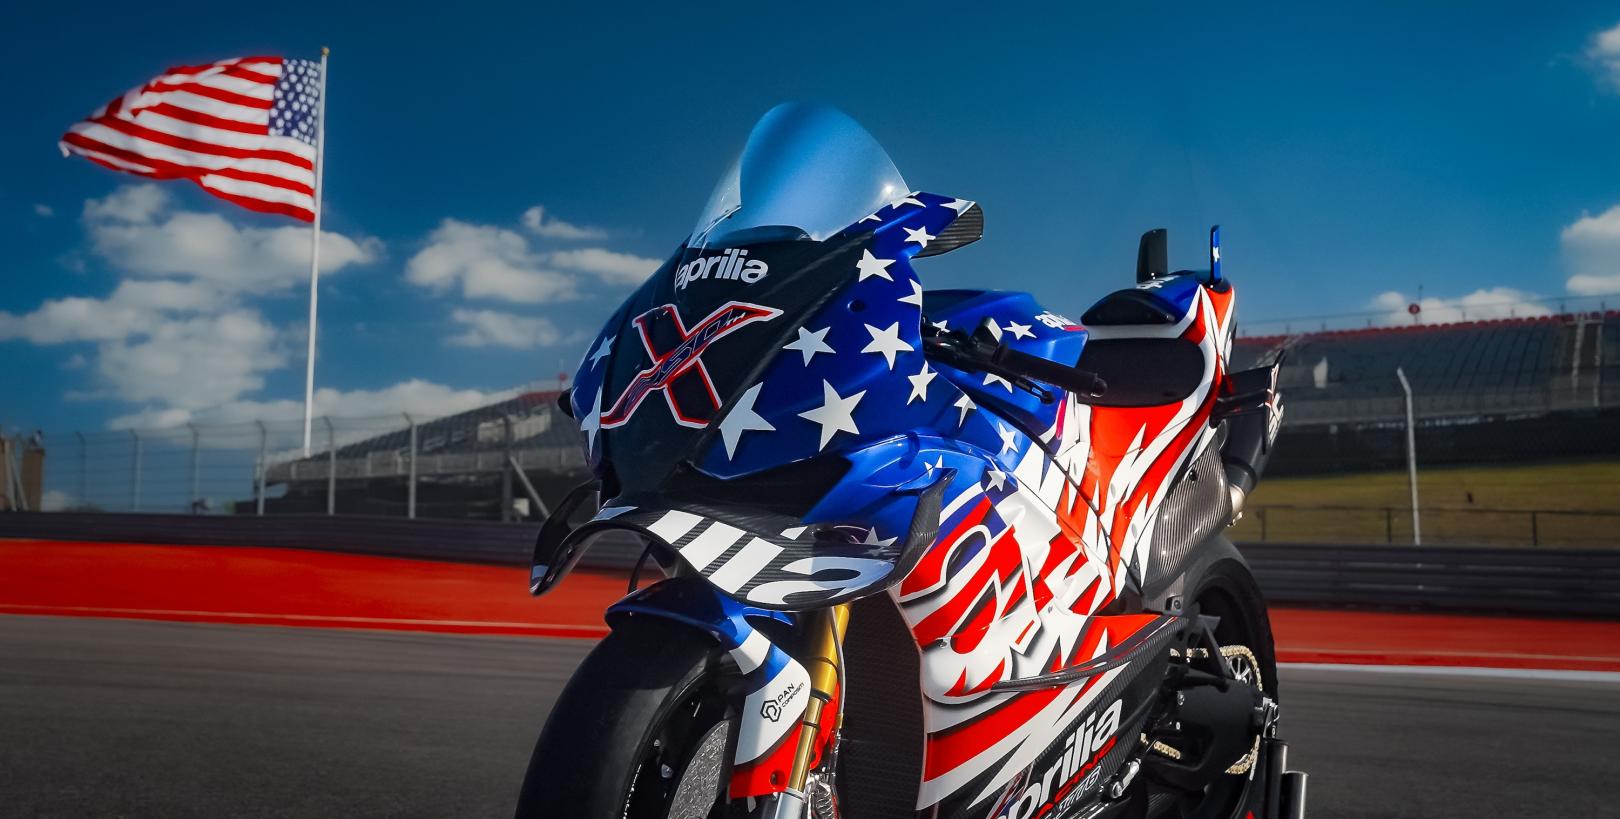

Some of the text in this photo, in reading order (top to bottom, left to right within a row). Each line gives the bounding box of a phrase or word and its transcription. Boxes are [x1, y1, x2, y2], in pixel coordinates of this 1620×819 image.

[675, 249, 769, 290] aprilia
[777, 682, 795, 702] PAN
[998, 699, 1123, 819] prilia
